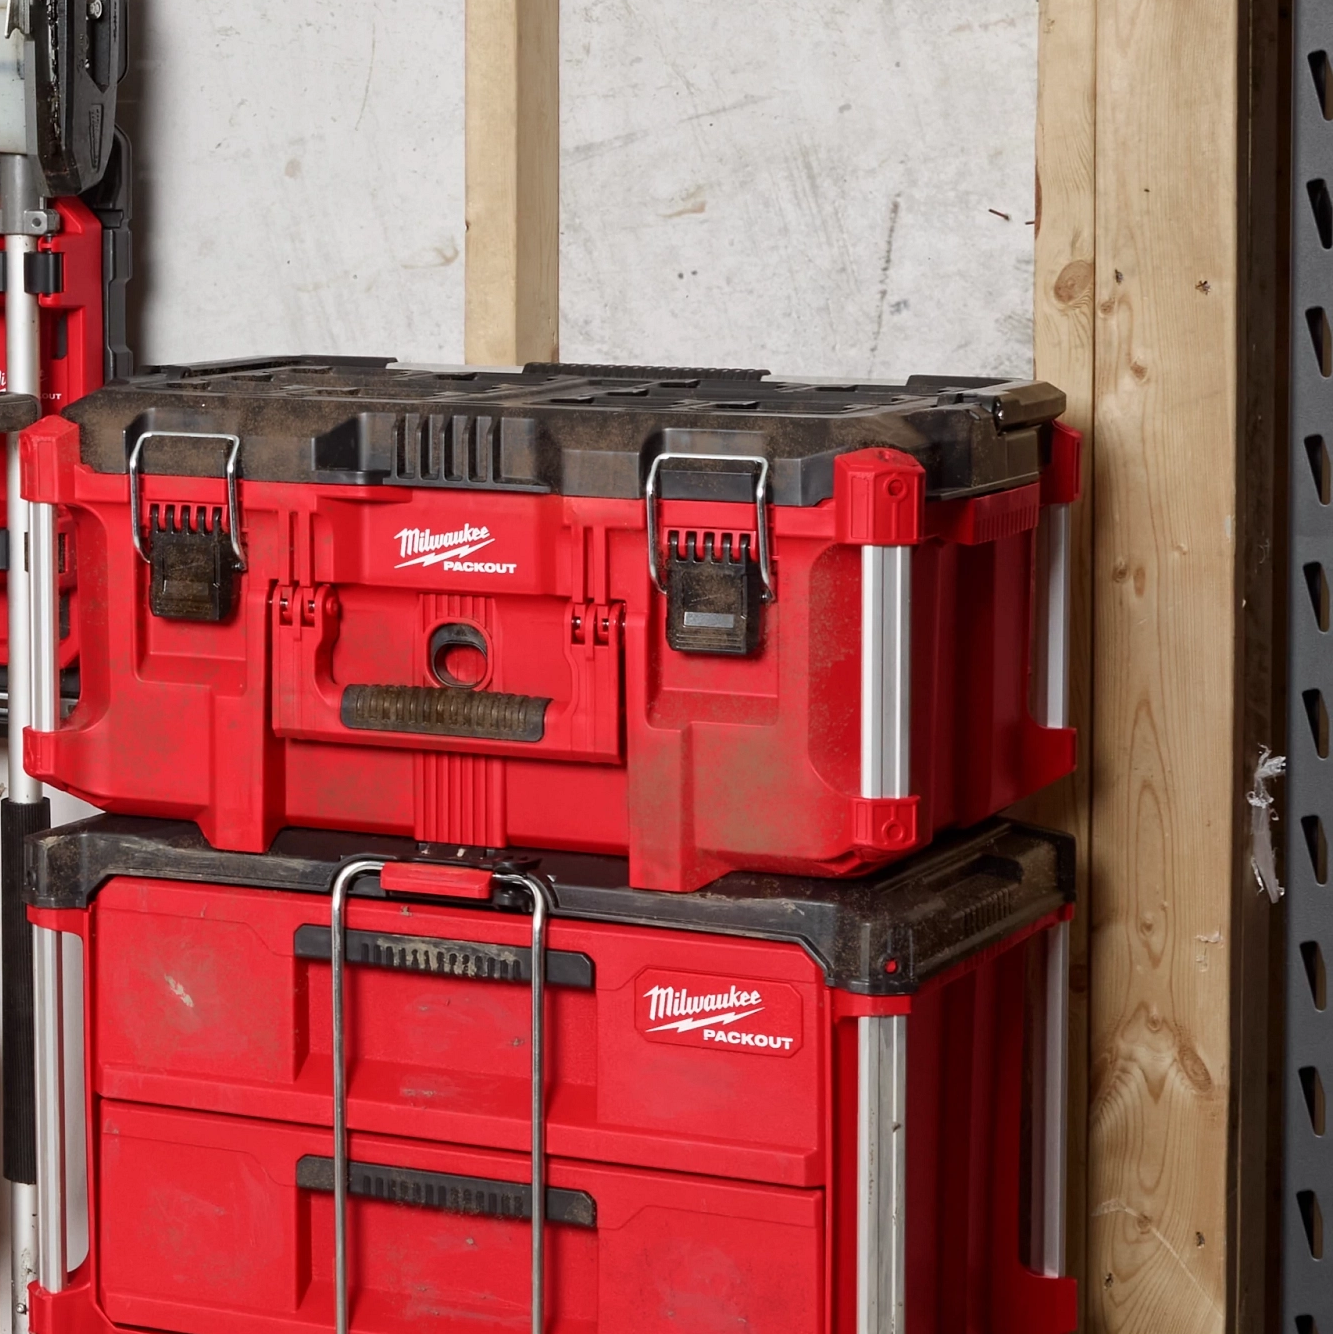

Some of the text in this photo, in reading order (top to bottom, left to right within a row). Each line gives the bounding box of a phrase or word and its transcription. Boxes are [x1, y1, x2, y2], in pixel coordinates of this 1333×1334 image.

[393, 522, 491, 558] Milwaukee
[443, 560, 517, 574] PACKOUT
[643, 985, 762, 1021] Milwaukee
[703, 1028, 794, 1050] PACKOUT
